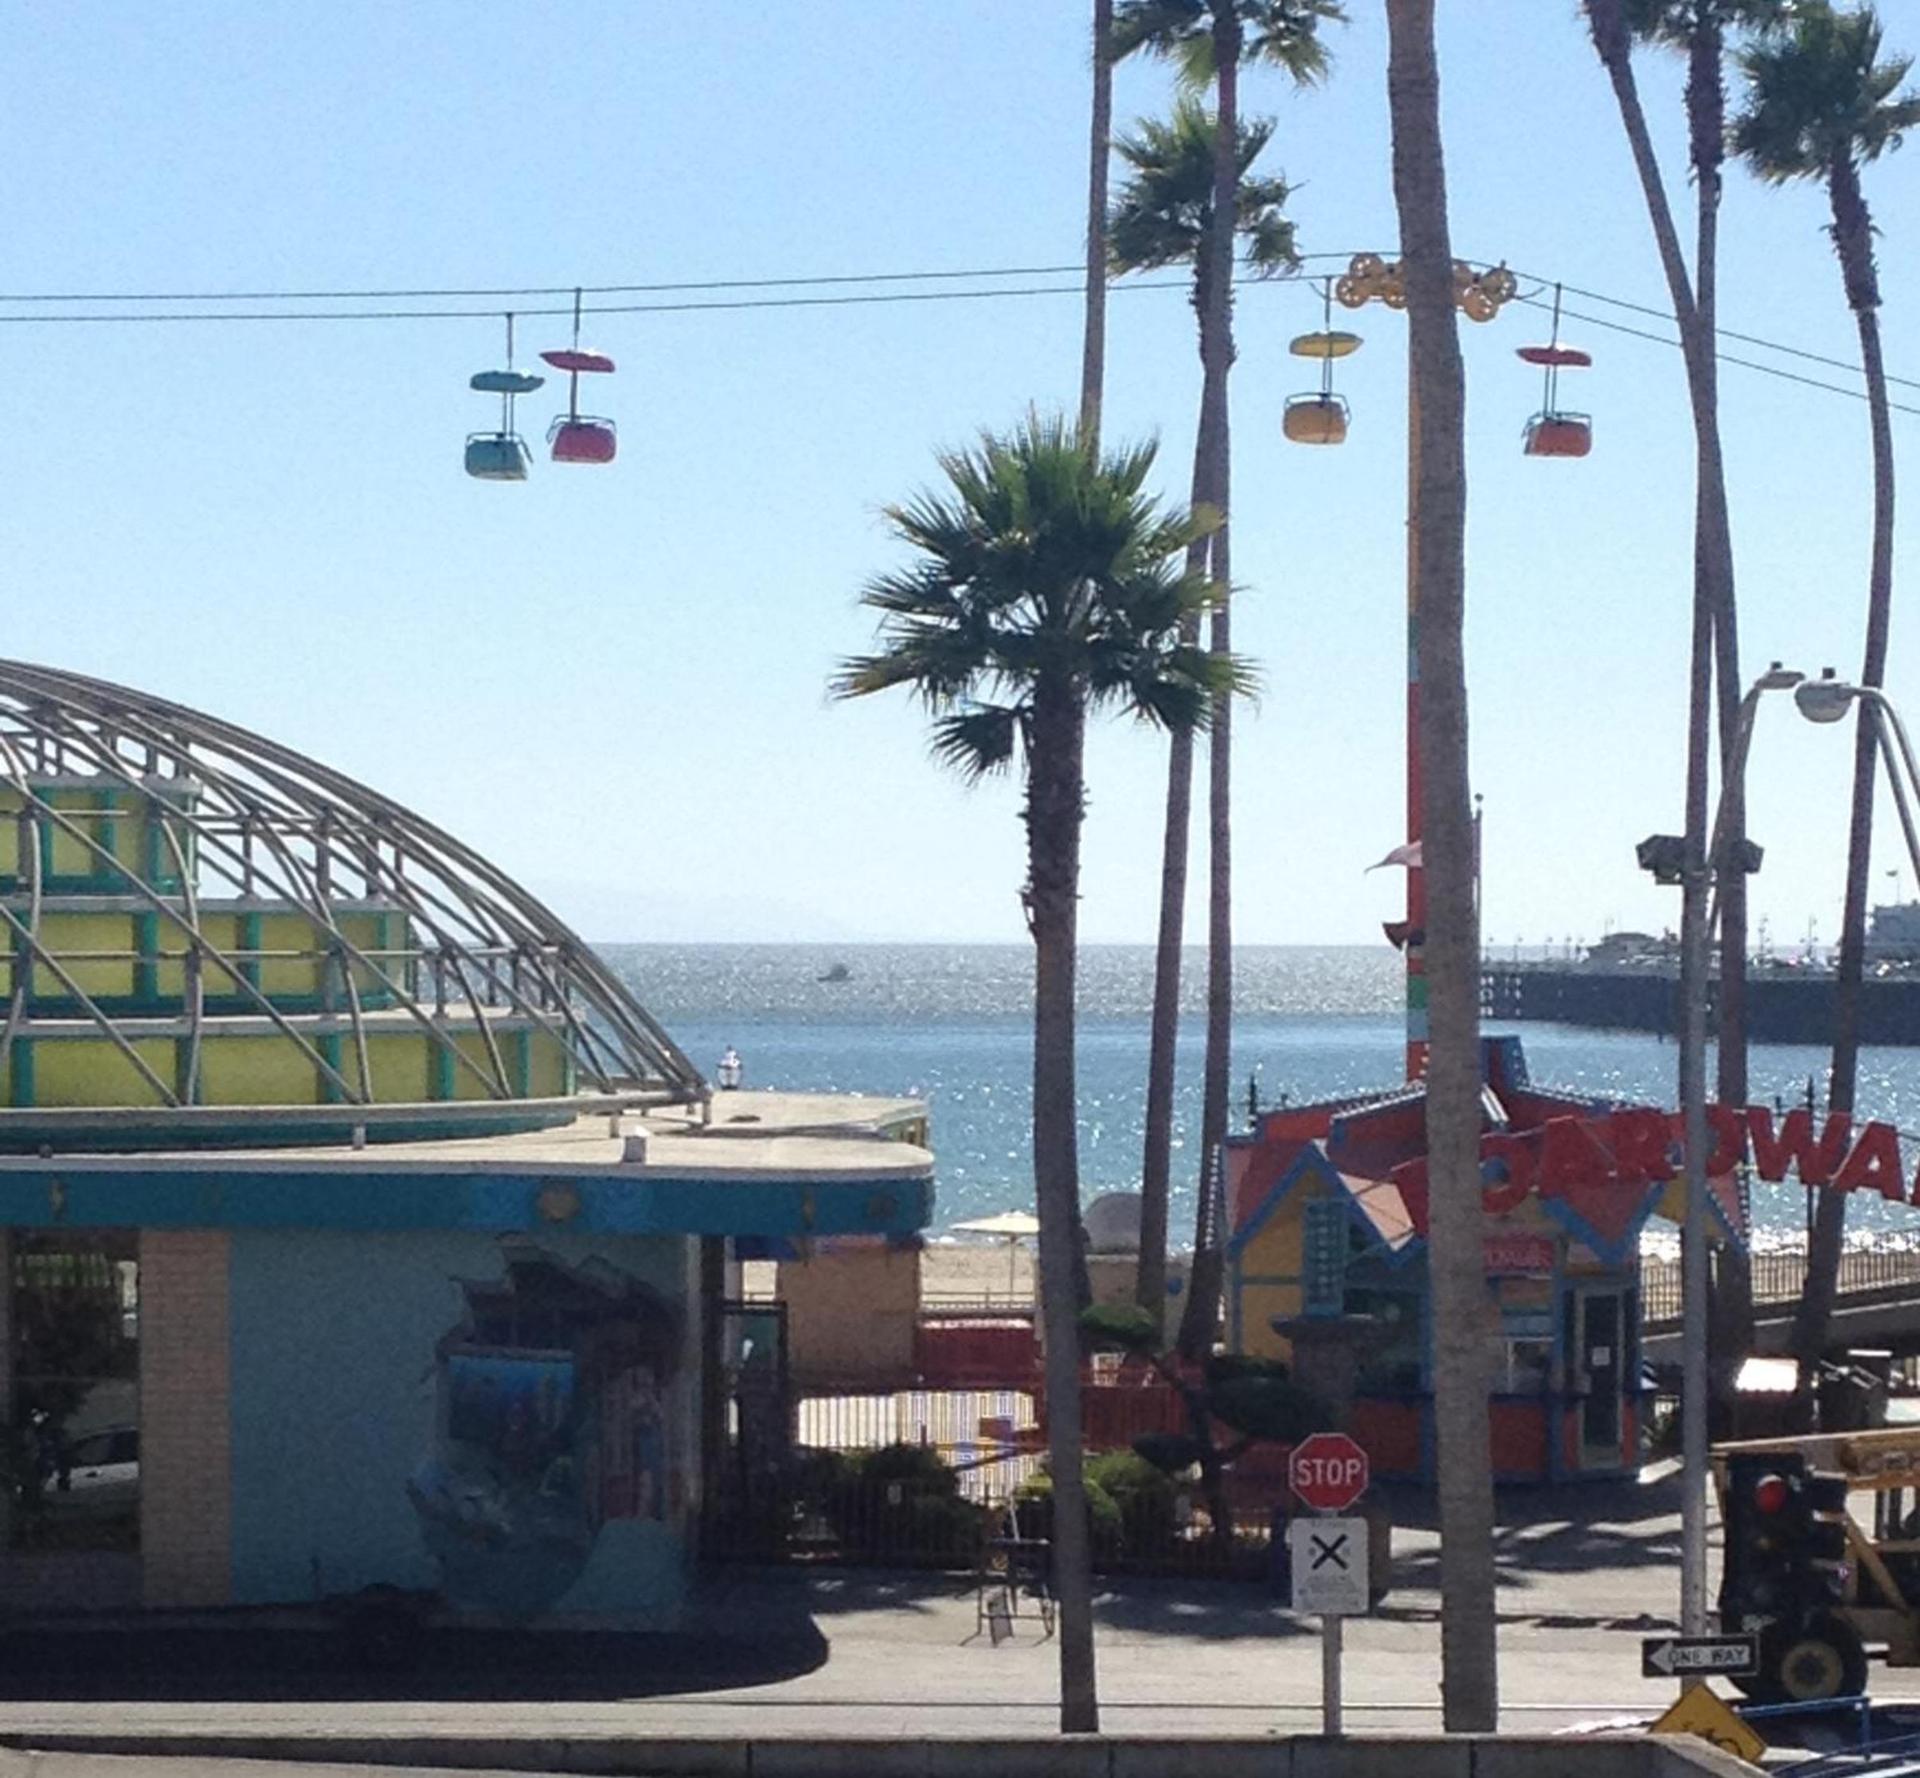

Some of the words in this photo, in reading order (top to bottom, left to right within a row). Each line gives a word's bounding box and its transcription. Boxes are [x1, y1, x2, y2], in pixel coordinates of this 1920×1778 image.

[1296, 1458, 1361, 1486] STOP
[1668, 1647, 1704, 1665] ONE
[1711, 1646, 1745, 1663] WAY
